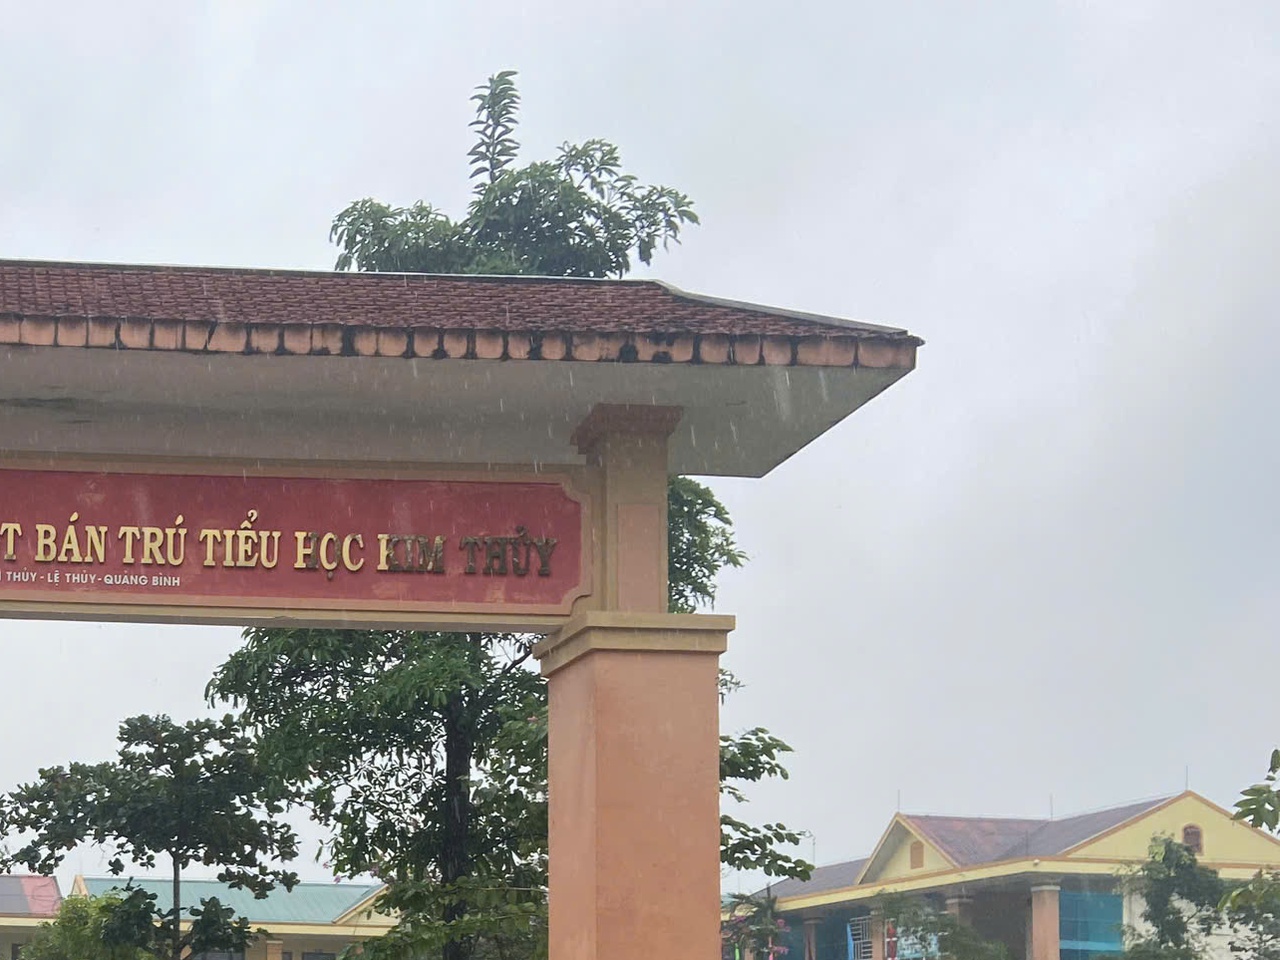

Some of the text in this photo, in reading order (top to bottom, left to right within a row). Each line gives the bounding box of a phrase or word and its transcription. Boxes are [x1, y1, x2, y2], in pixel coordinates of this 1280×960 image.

[34, 511, 108, 563] BÁN
[118, 513, 188, 566] TRÚ
[199, 509, 281, 569] TIỂU
[293, 531, 365, 581] HỌC
[376, 532, 447, 575] KIM
[459, 525, 558, 577] THỦY
[6, 567, 37, 582] THỦY
[47, 570, 60, 587] LỆ
[151, 571, 181, 587] BÌNH
